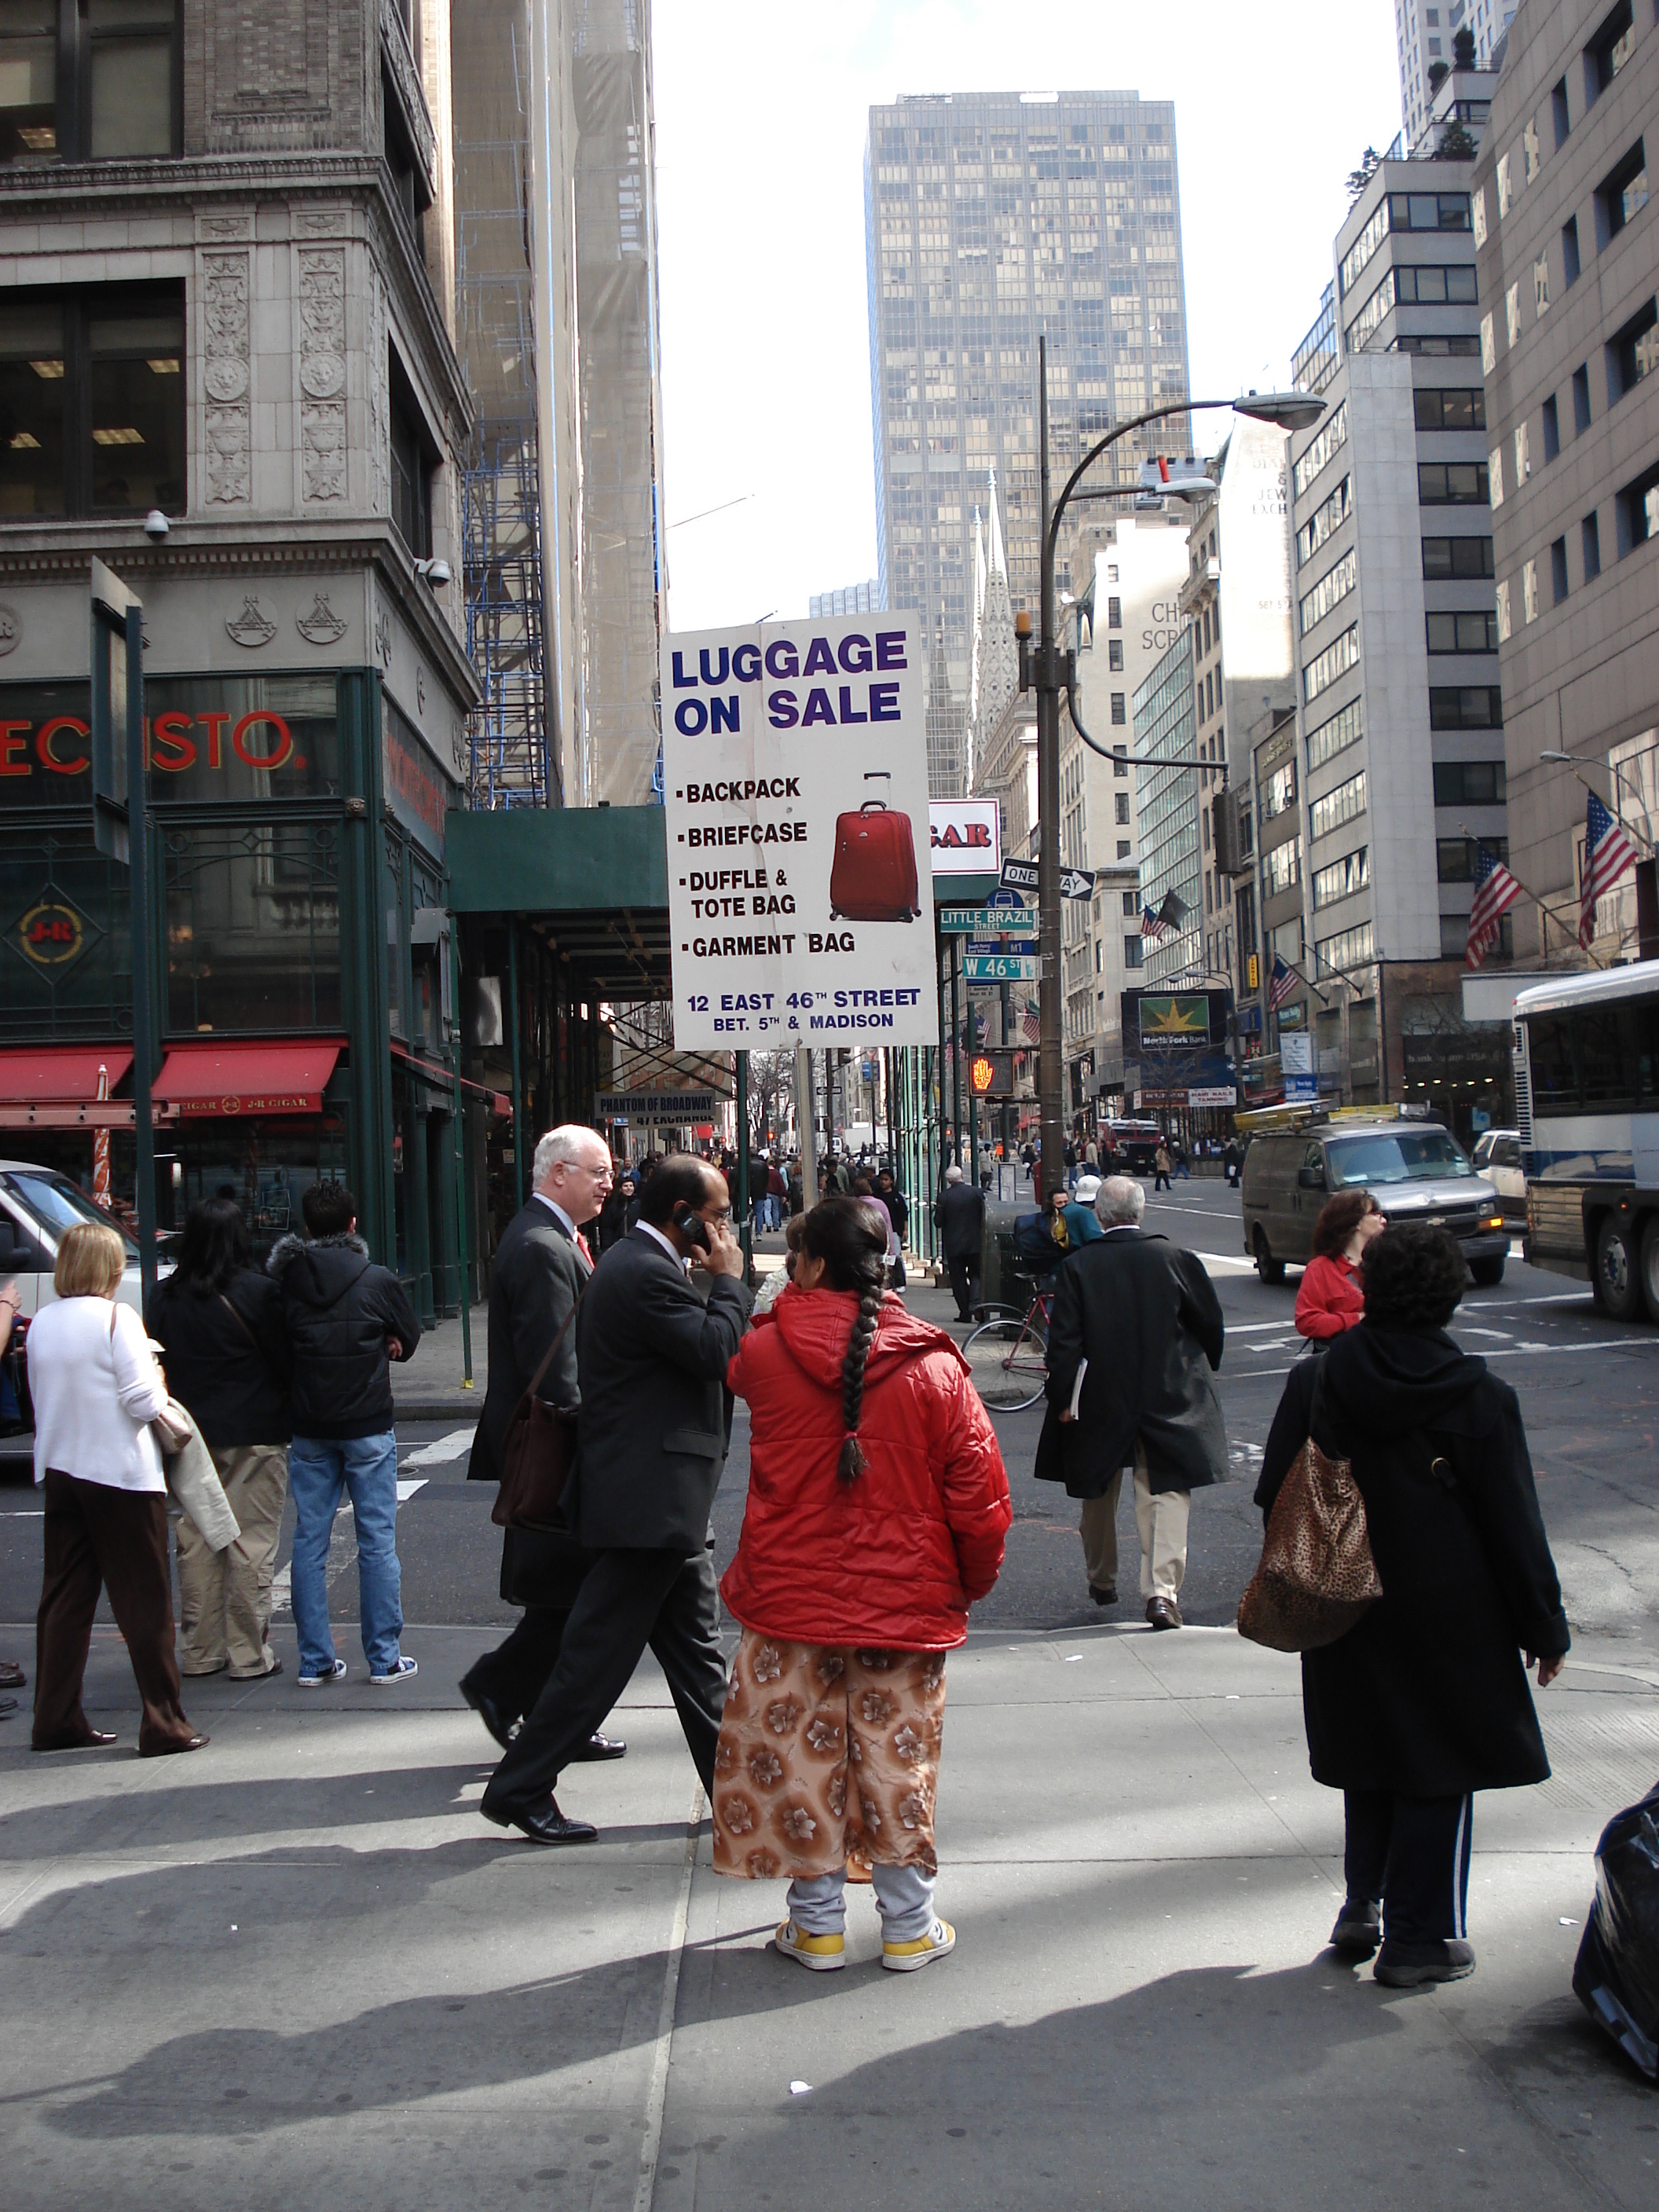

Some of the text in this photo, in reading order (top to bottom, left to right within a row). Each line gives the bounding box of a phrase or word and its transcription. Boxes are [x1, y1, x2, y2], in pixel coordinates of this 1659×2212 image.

[672, 630, 908, 688] LUGGAGE
[674, 682, 902, 737] ON SALE
[686, 777, 801, 804] BACKPACK
[688, 822, 808, 848] BRIEFCASE
[689, 869, 788, 892] DUFFLE &
[1009, 868, 1036, 883] ONE
[690, 894, 796, 919] TOTE BAG
[940, 910, 1033, 924] LITTLE BRAZIL
[692, 932, 855, 958] GARMENT BAG
[1010, 943, 1022, 953] M1
[965, 958, 1021, 976] W 46 ST
[687, 994, 709, 1013] 12
[720, 993, 775, 1012] EAST
[833, 988, 921, 1008] STREET
[713, 1013, 894, 1031] BET. 5TH & MADISON
[1168, 1035, 1188, 1044] Fork
[269, 1098, 307, 1107] CIGAR
[600, 1096, 712, 1113] PHANTOM OF BROADWAY
